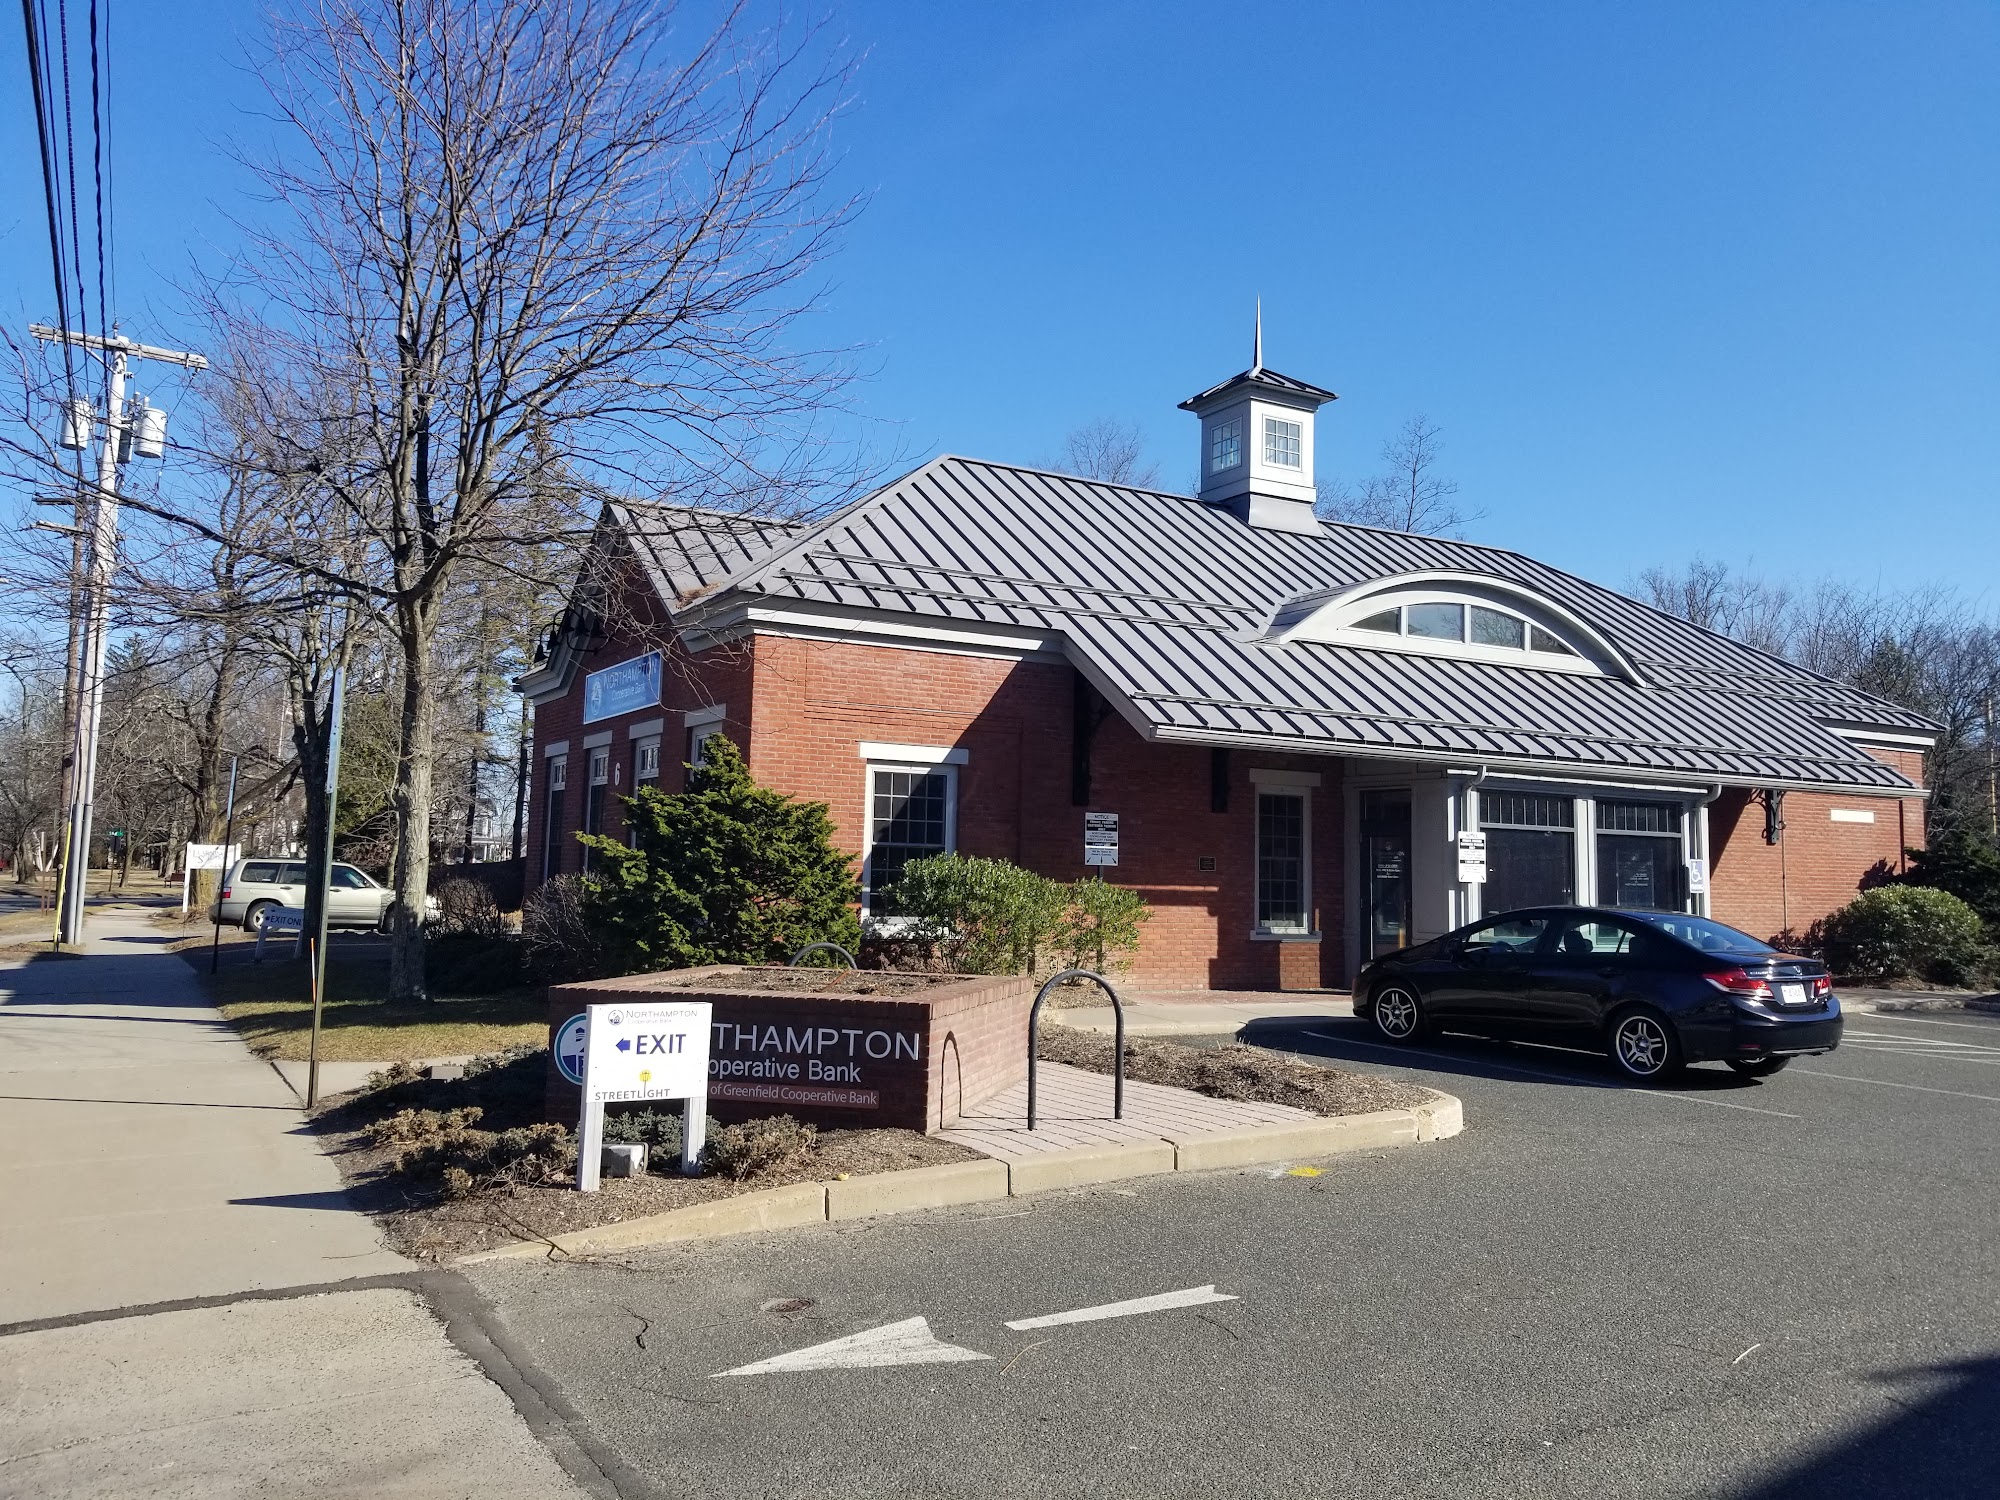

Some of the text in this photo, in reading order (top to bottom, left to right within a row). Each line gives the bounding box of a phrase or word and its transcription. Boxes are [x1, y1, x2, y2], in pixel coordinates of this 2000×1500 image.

[603, 658, 657, 691] NORTHAMPTON
[614, 762, 621, 786] 6
[270, 915, 302, 926] EXIT ONL
[625, 1010, 698, 1019] NORTHAMPTON
[636, 1034, 687, 1055] EXIT
[711, 1022, 920, 1061] THAMPTON
[708, 1057, 862, 1083] operative Bank
[594, 1088, 671, 1101] STREETLIGHT
[710, 1082, 878, 1105] of Greenfield Cooperative Bank
